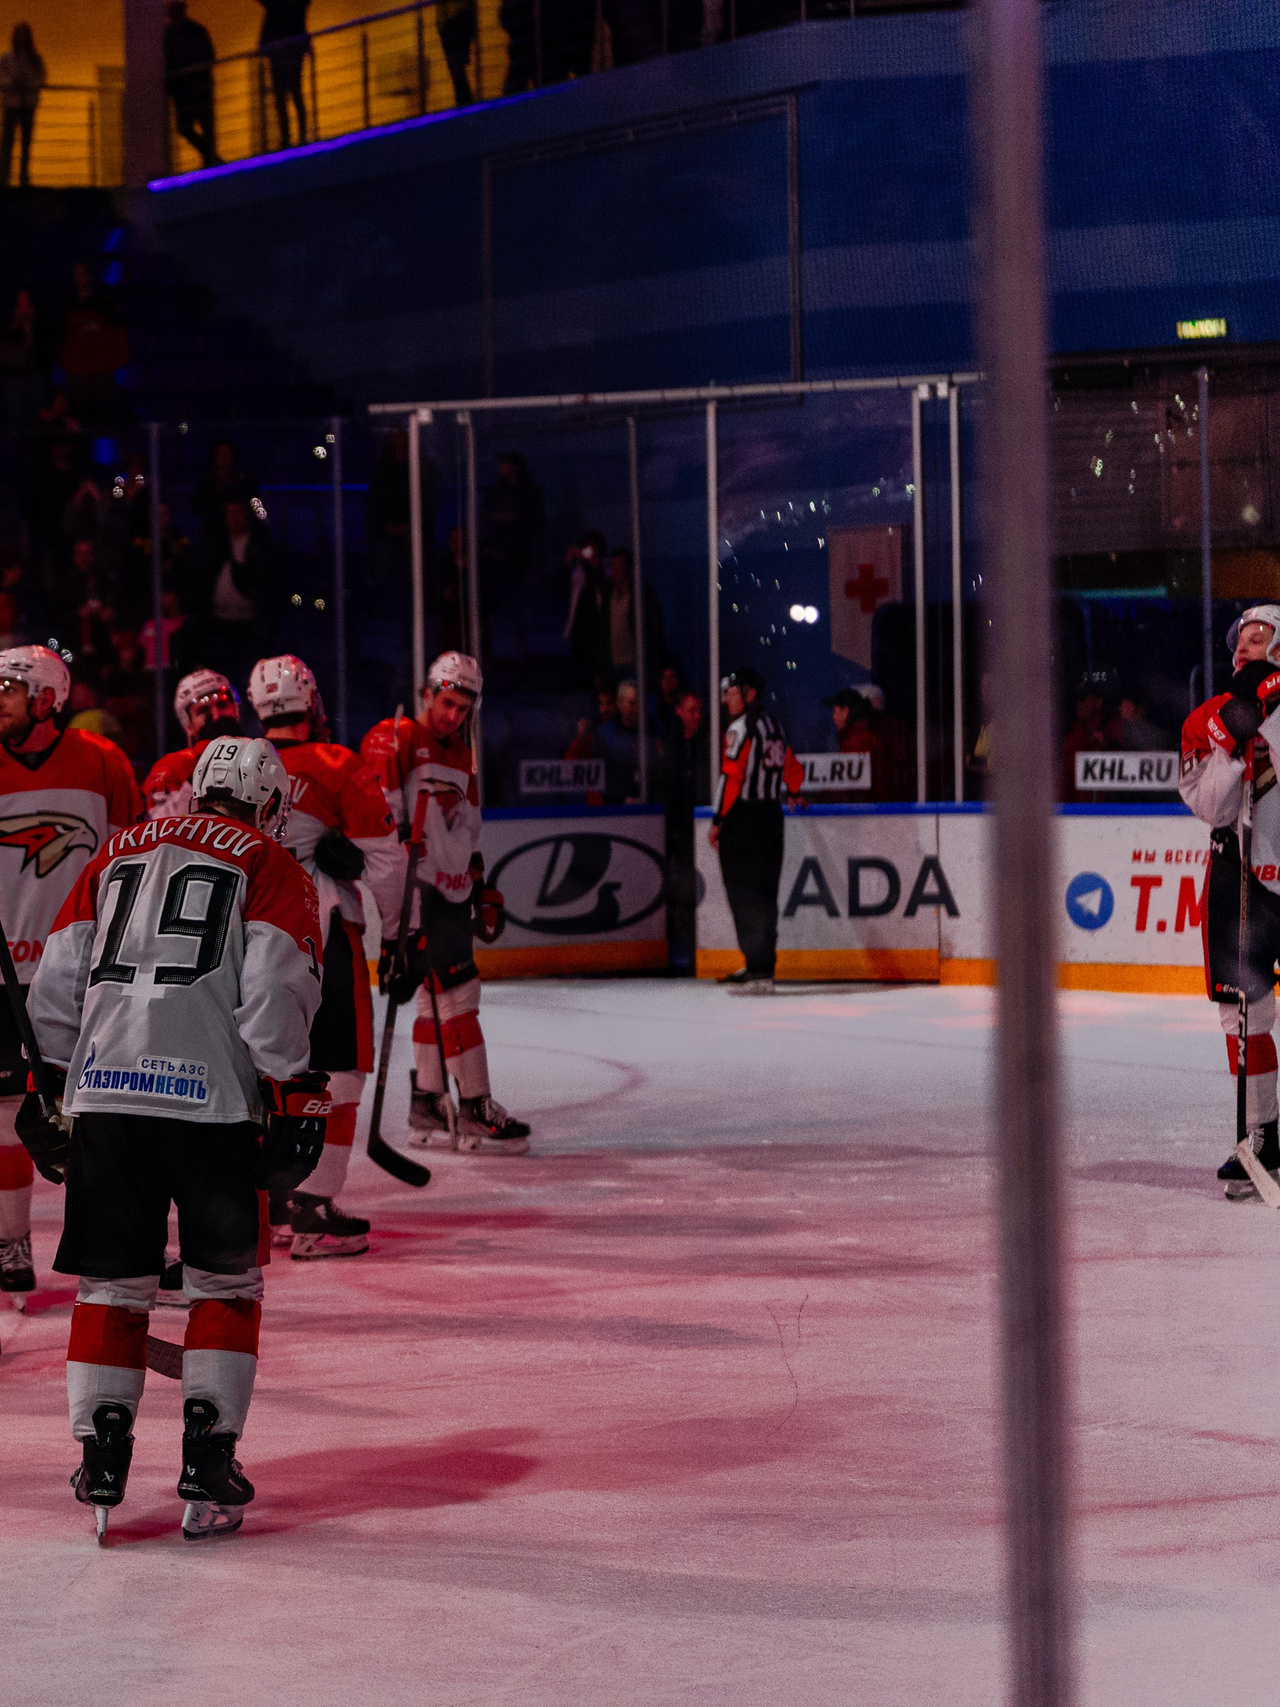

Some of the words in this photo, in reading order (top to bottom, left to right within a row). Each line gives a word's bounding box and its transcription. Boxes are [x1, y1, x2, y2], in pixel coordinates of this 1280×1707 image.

[214, 744, 238, 761] 19
[526, 763, 600, 786] KHL.RU
[802, 759, 864, 783] L.RU
[1082, 757, 1173, 783] KHL.RU
[107, 816, 263, 858] TKACHYOV
[1131, 849, 1157, 864] МЫ
[783, 856, 960, 917] ADA
[87, 861, 245, 988] 19
[140, 1058, 175, 1072] СЕТЬ
[178, 1063, 206, 1076] АЗС
[86, 1069, 207, 1101] ГАЗПРОМНЕФТЬ
